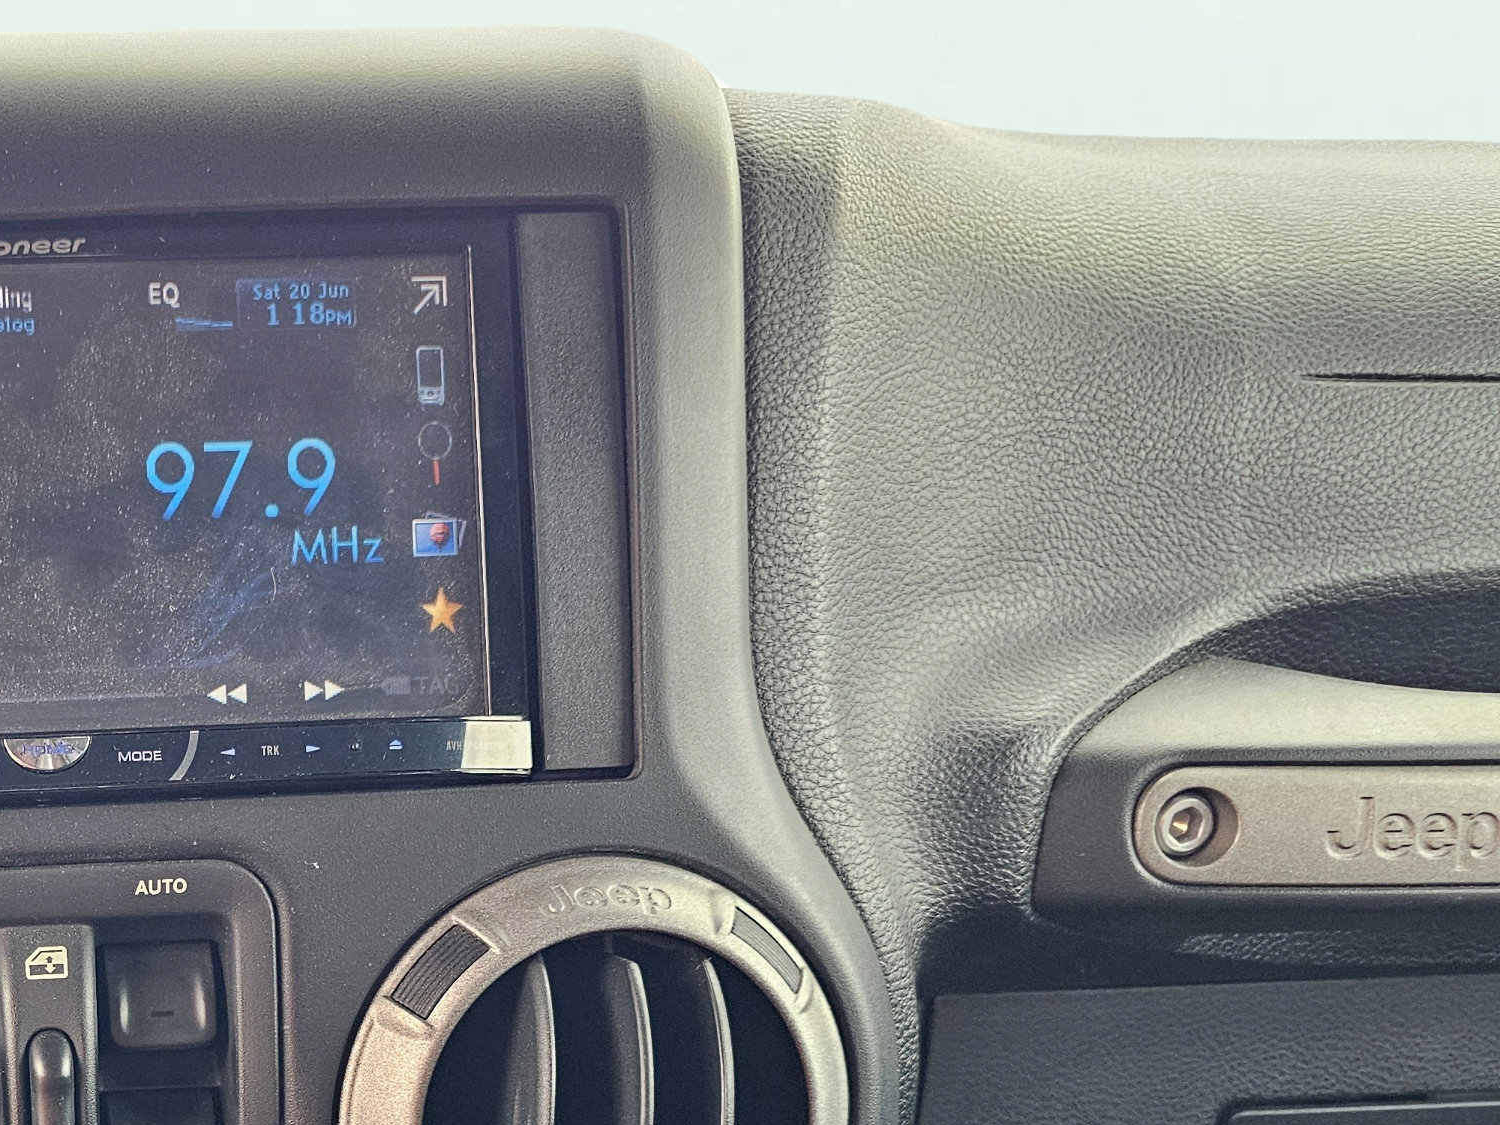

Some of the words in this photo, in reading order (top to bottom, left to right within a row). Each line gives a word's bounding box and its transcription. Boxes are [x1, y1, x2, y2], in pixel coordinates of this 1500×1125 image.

[148, 281, 181, 308] EQ
[252, 282, 281, 301] Sat
[289, 281, 310, 300] 20
[317, 281, 350, 299] Jun
[146, 437, 336, 522] 97.9
[291, 525, 385, 566] MHz
[118, 750, 162, 762] MODE
[261, 745, 280, 756] TRK
[1326, 795, 1500, 872] Jeep
[135, 878, 188, 896] AUTO
[538, 884, 672, 917] Jeep
